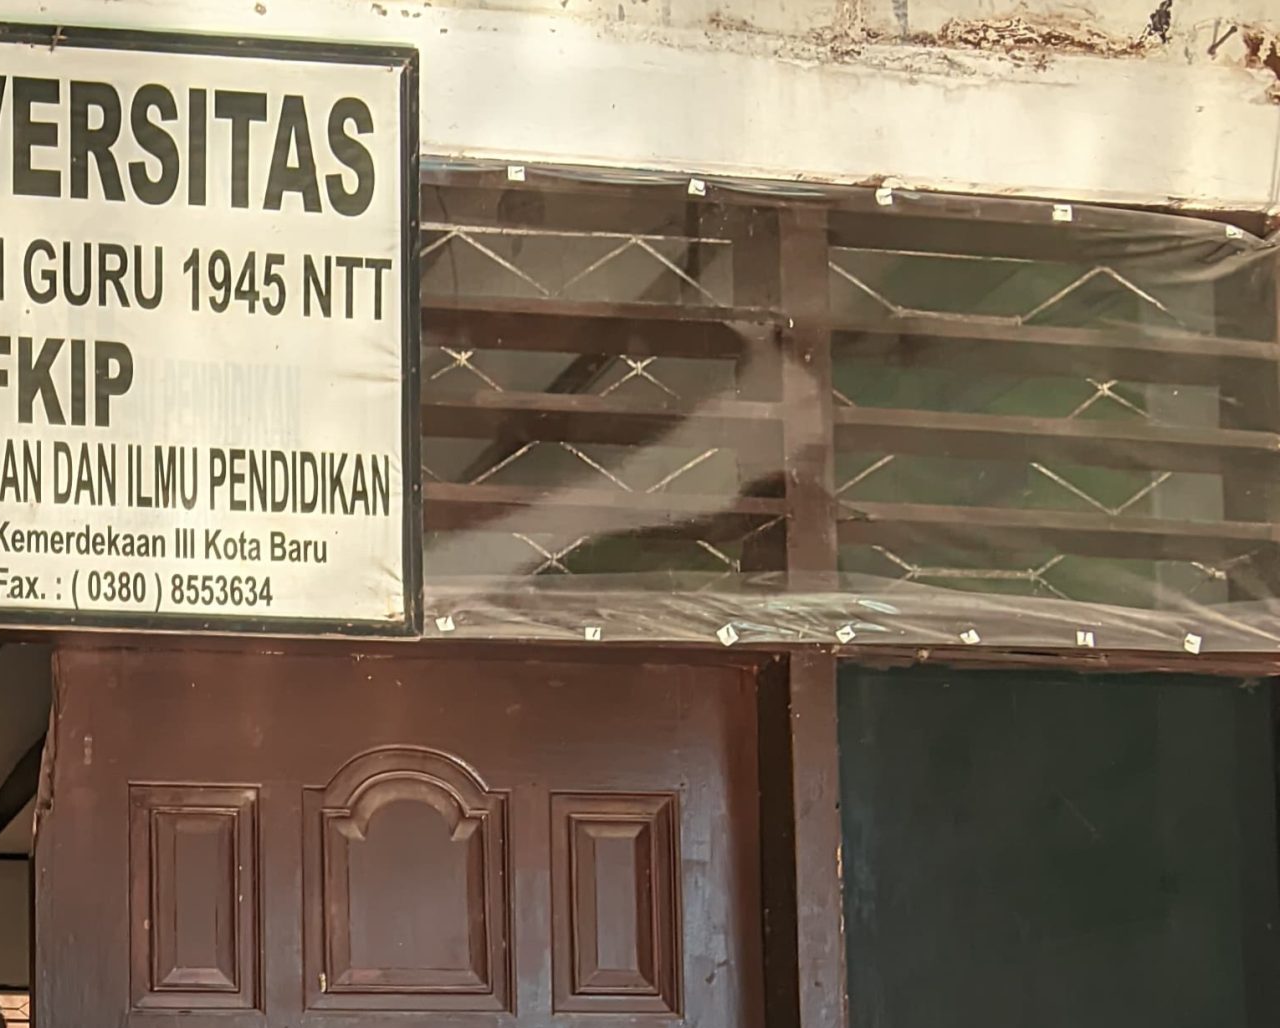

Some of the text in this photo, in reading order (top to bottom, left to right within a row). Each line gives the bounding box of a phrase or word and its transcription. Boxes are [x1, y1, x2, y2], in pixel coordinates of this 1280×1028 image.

[23, 239, 163, 310] GURU
[183, 248, 286, 316] 1945
[303, 254, 393, 320] NTT
[53, 441, 116, 506] DAN
[127, 444, 198, 510] ILMU
[209, 448, 390, 516] PENDIDIKAN
[175, 528, 195, 559] III
[204, 529, 261, 561] Kota
[270, 531, 327, 563] Baru
[171, 573, 273, 606] 8553634
